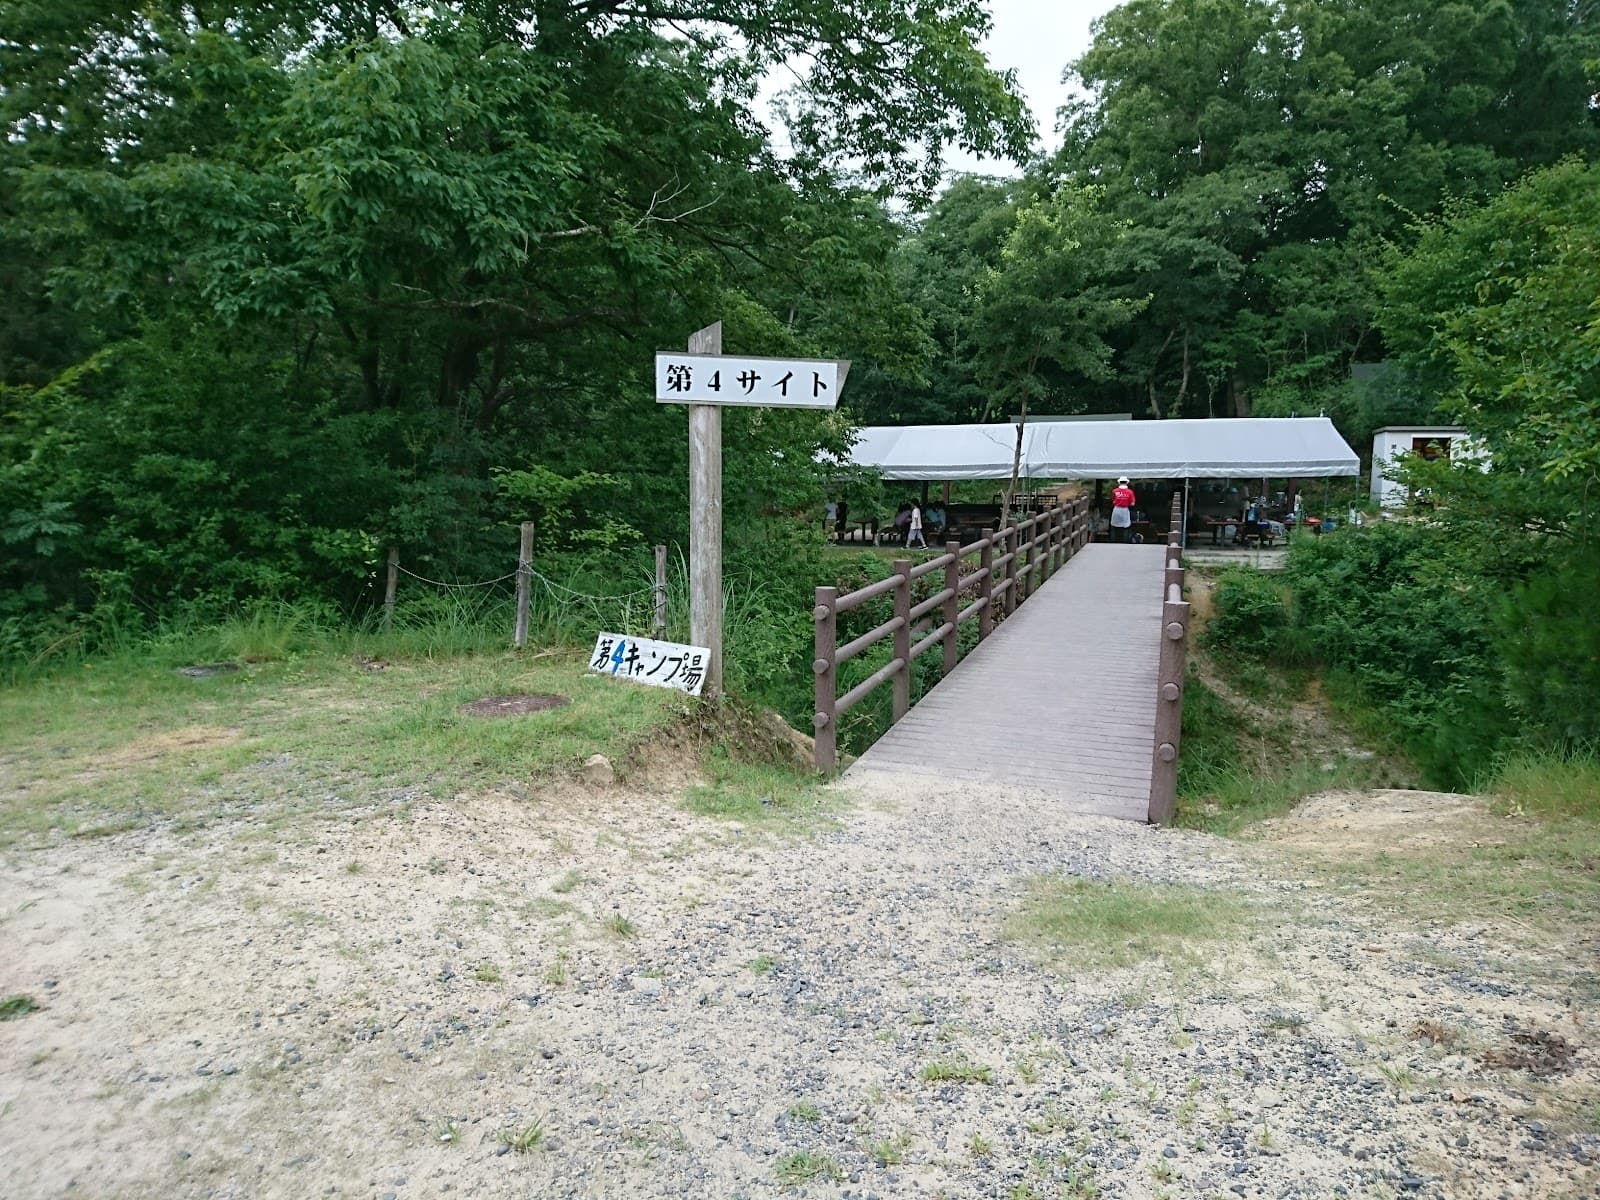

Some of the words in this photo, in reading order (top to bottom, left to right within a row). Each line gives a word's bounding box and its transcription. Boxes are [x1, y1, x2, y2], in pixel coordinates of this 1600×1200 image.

[666, 364, 828, 397] 第4サイト
[592, 639, 703, 690] 第4キャンプ場
